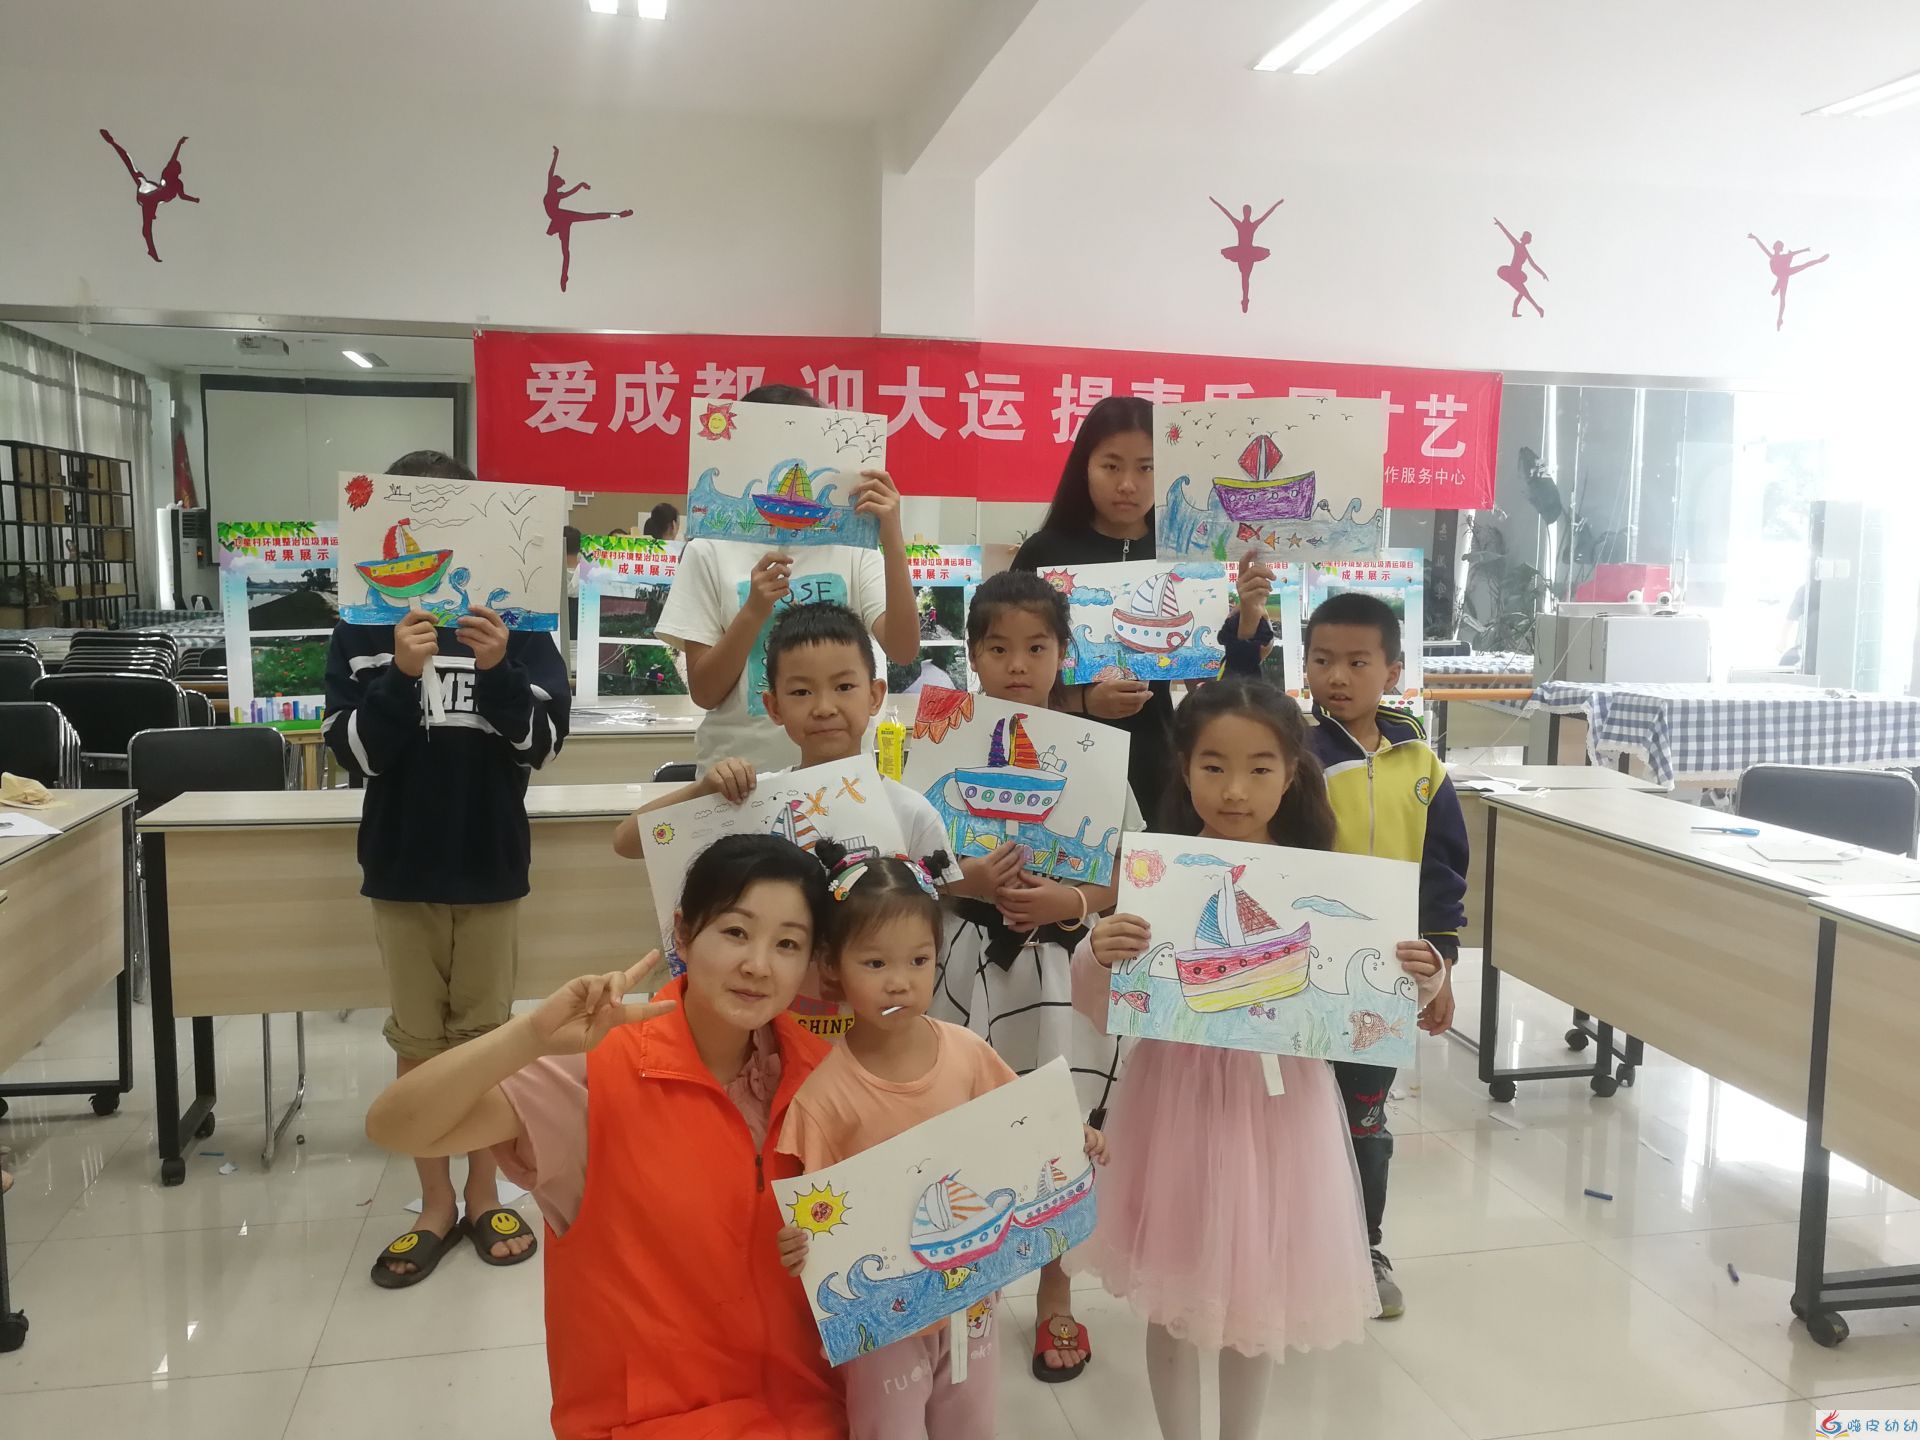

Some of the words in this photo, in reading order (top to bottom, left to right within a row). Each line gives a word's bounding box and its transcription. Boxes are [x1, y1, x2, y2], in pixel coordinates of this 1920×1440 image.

[264, 548, 330, 562] 成果展示
[618, 562, 676, 577] 成果展示
[1341, 569, 1391, 581] 成果展示
